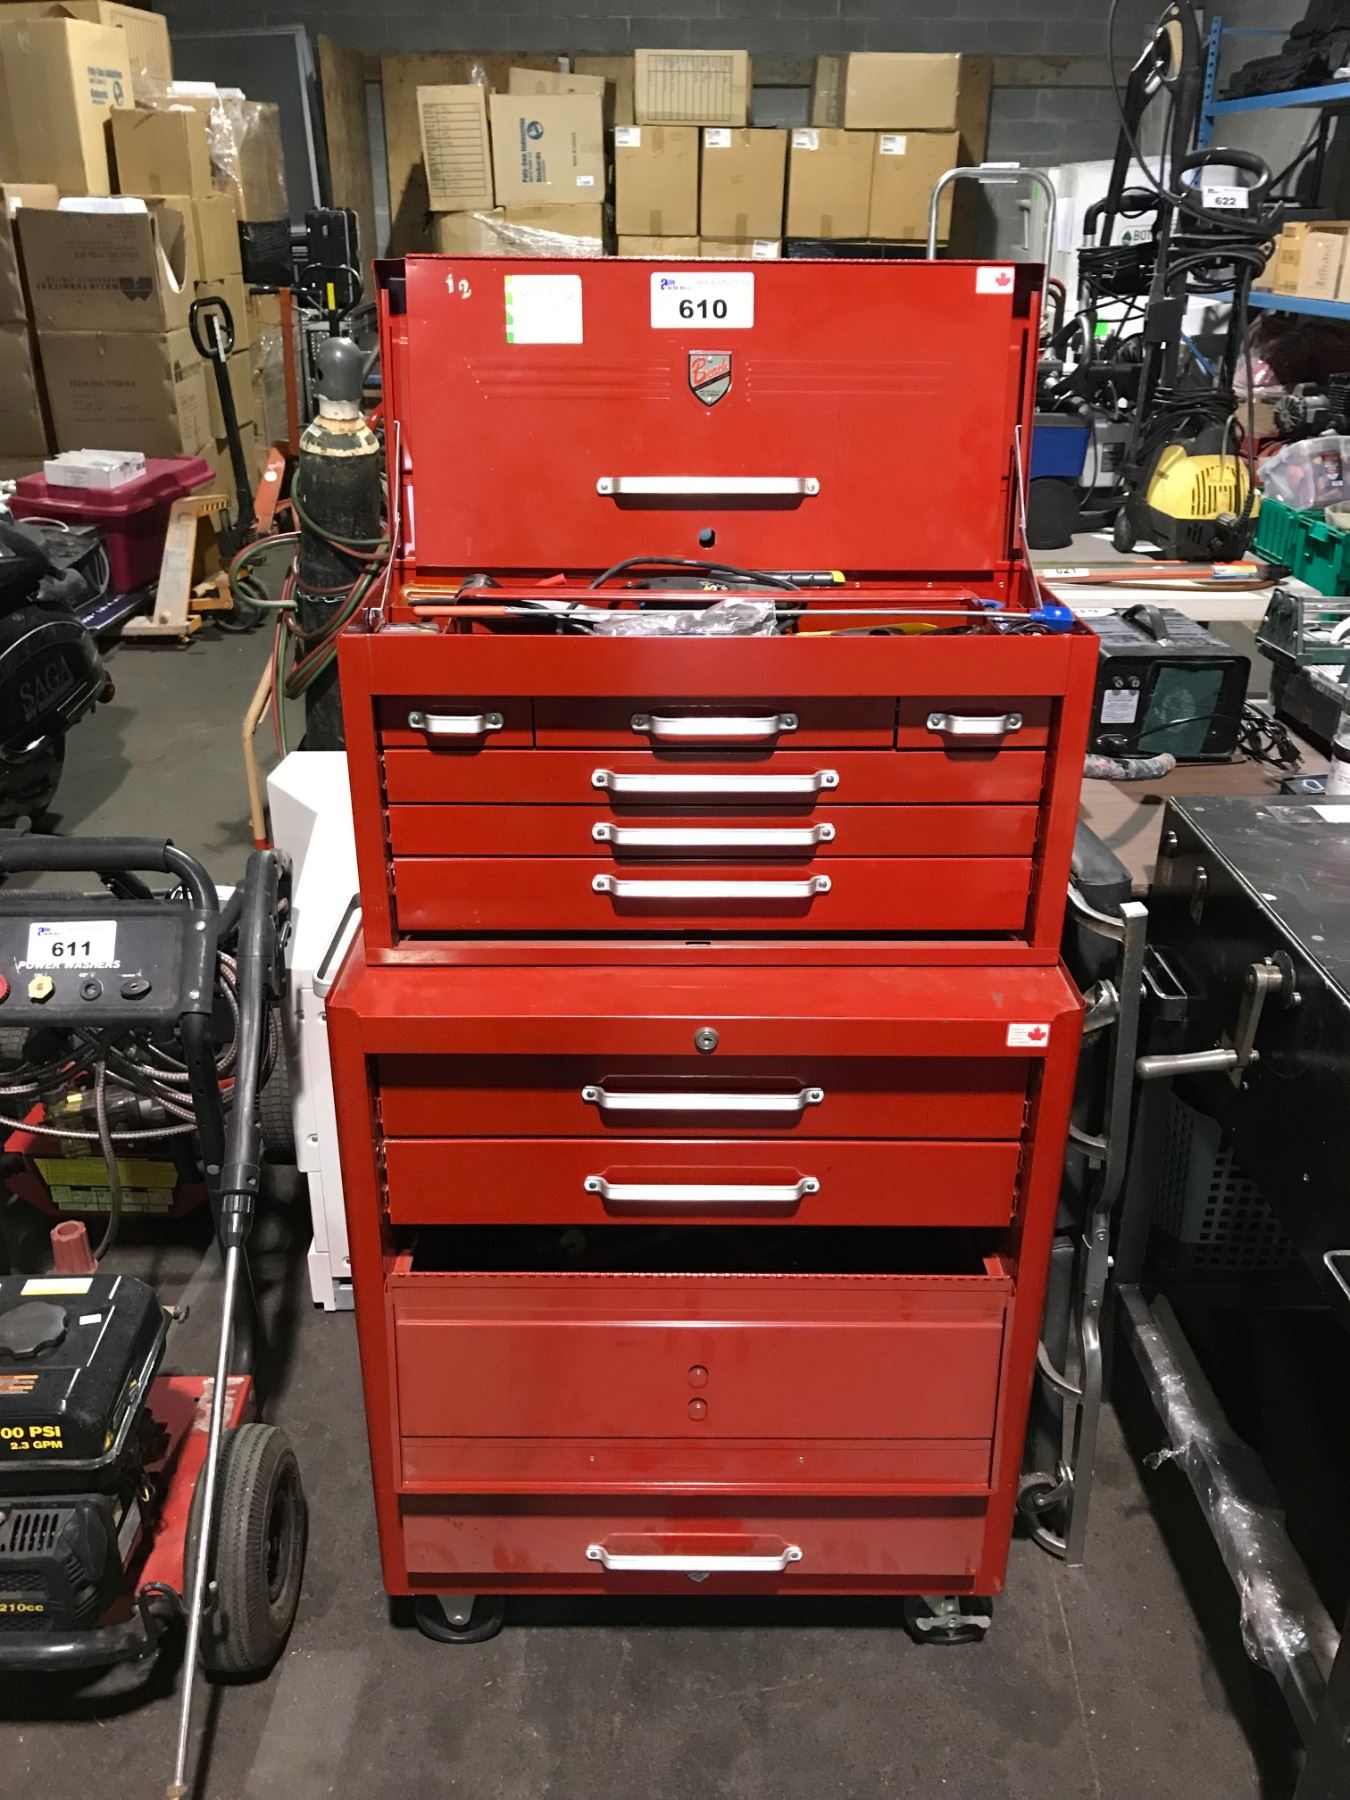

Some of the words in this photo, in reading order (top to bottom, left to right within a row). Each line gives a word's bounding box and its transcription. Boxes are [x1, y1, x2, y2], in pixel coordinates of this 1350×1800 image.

[1215, 197, 1237, 206] 622
[679, 299, 728, 319] 610
[20, 655, 75, 711] SAGA
[52, 940, 90, 957] 611
[29, 1425, 61, 1438] PSI
[10, 1441, 30, 1450] 2.3
[33, 1440, 63, 1449] GPM
